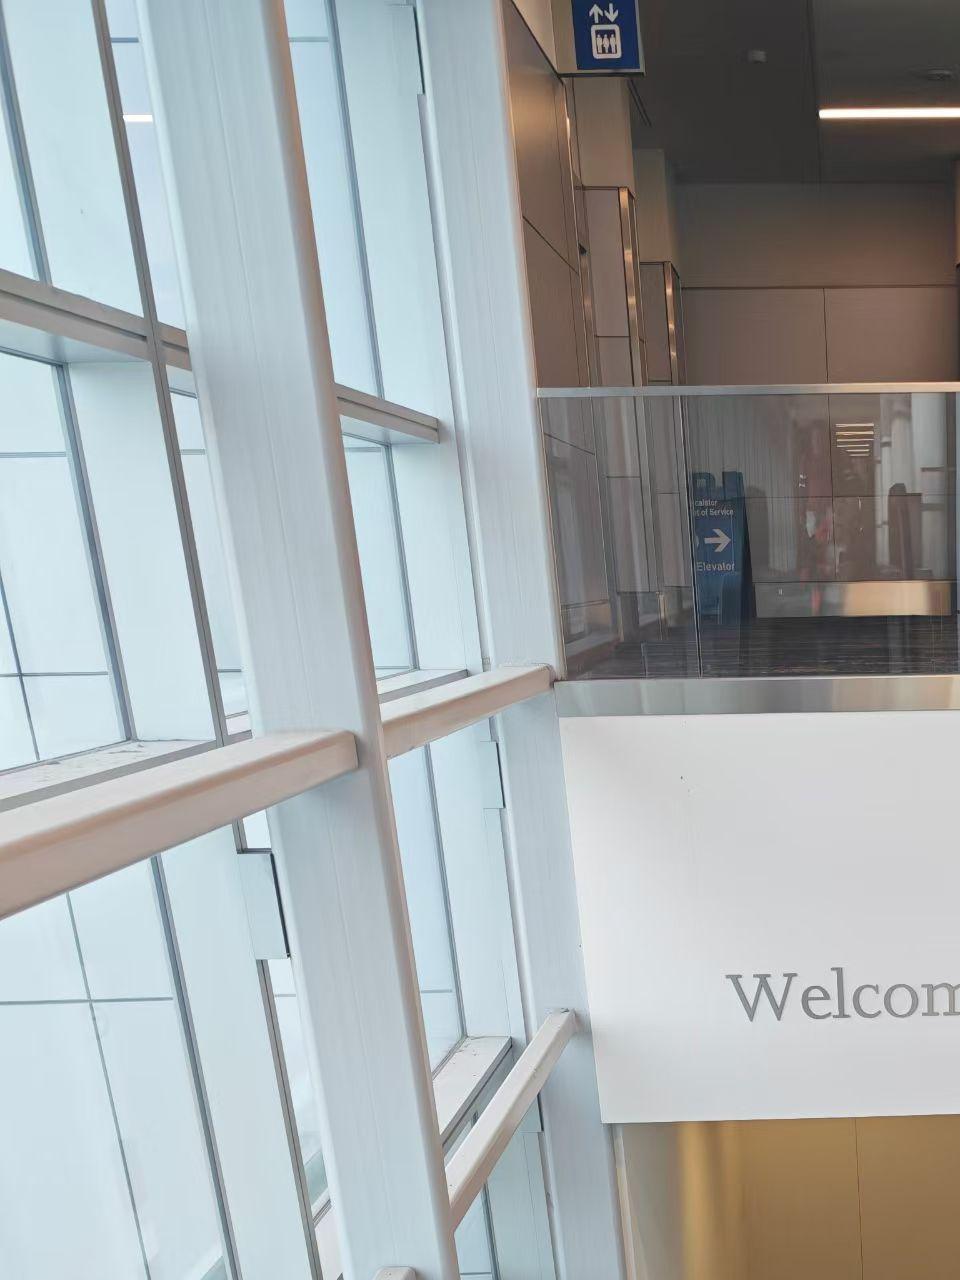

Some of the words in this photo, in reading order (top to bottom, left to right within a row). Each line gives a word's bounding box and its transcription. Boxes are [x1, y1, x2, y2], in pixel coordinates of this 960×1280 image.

[700, 508, 708, 517] of
[709, 508, 734, 516] Service
[696, 561, 735, 572] Elevator
